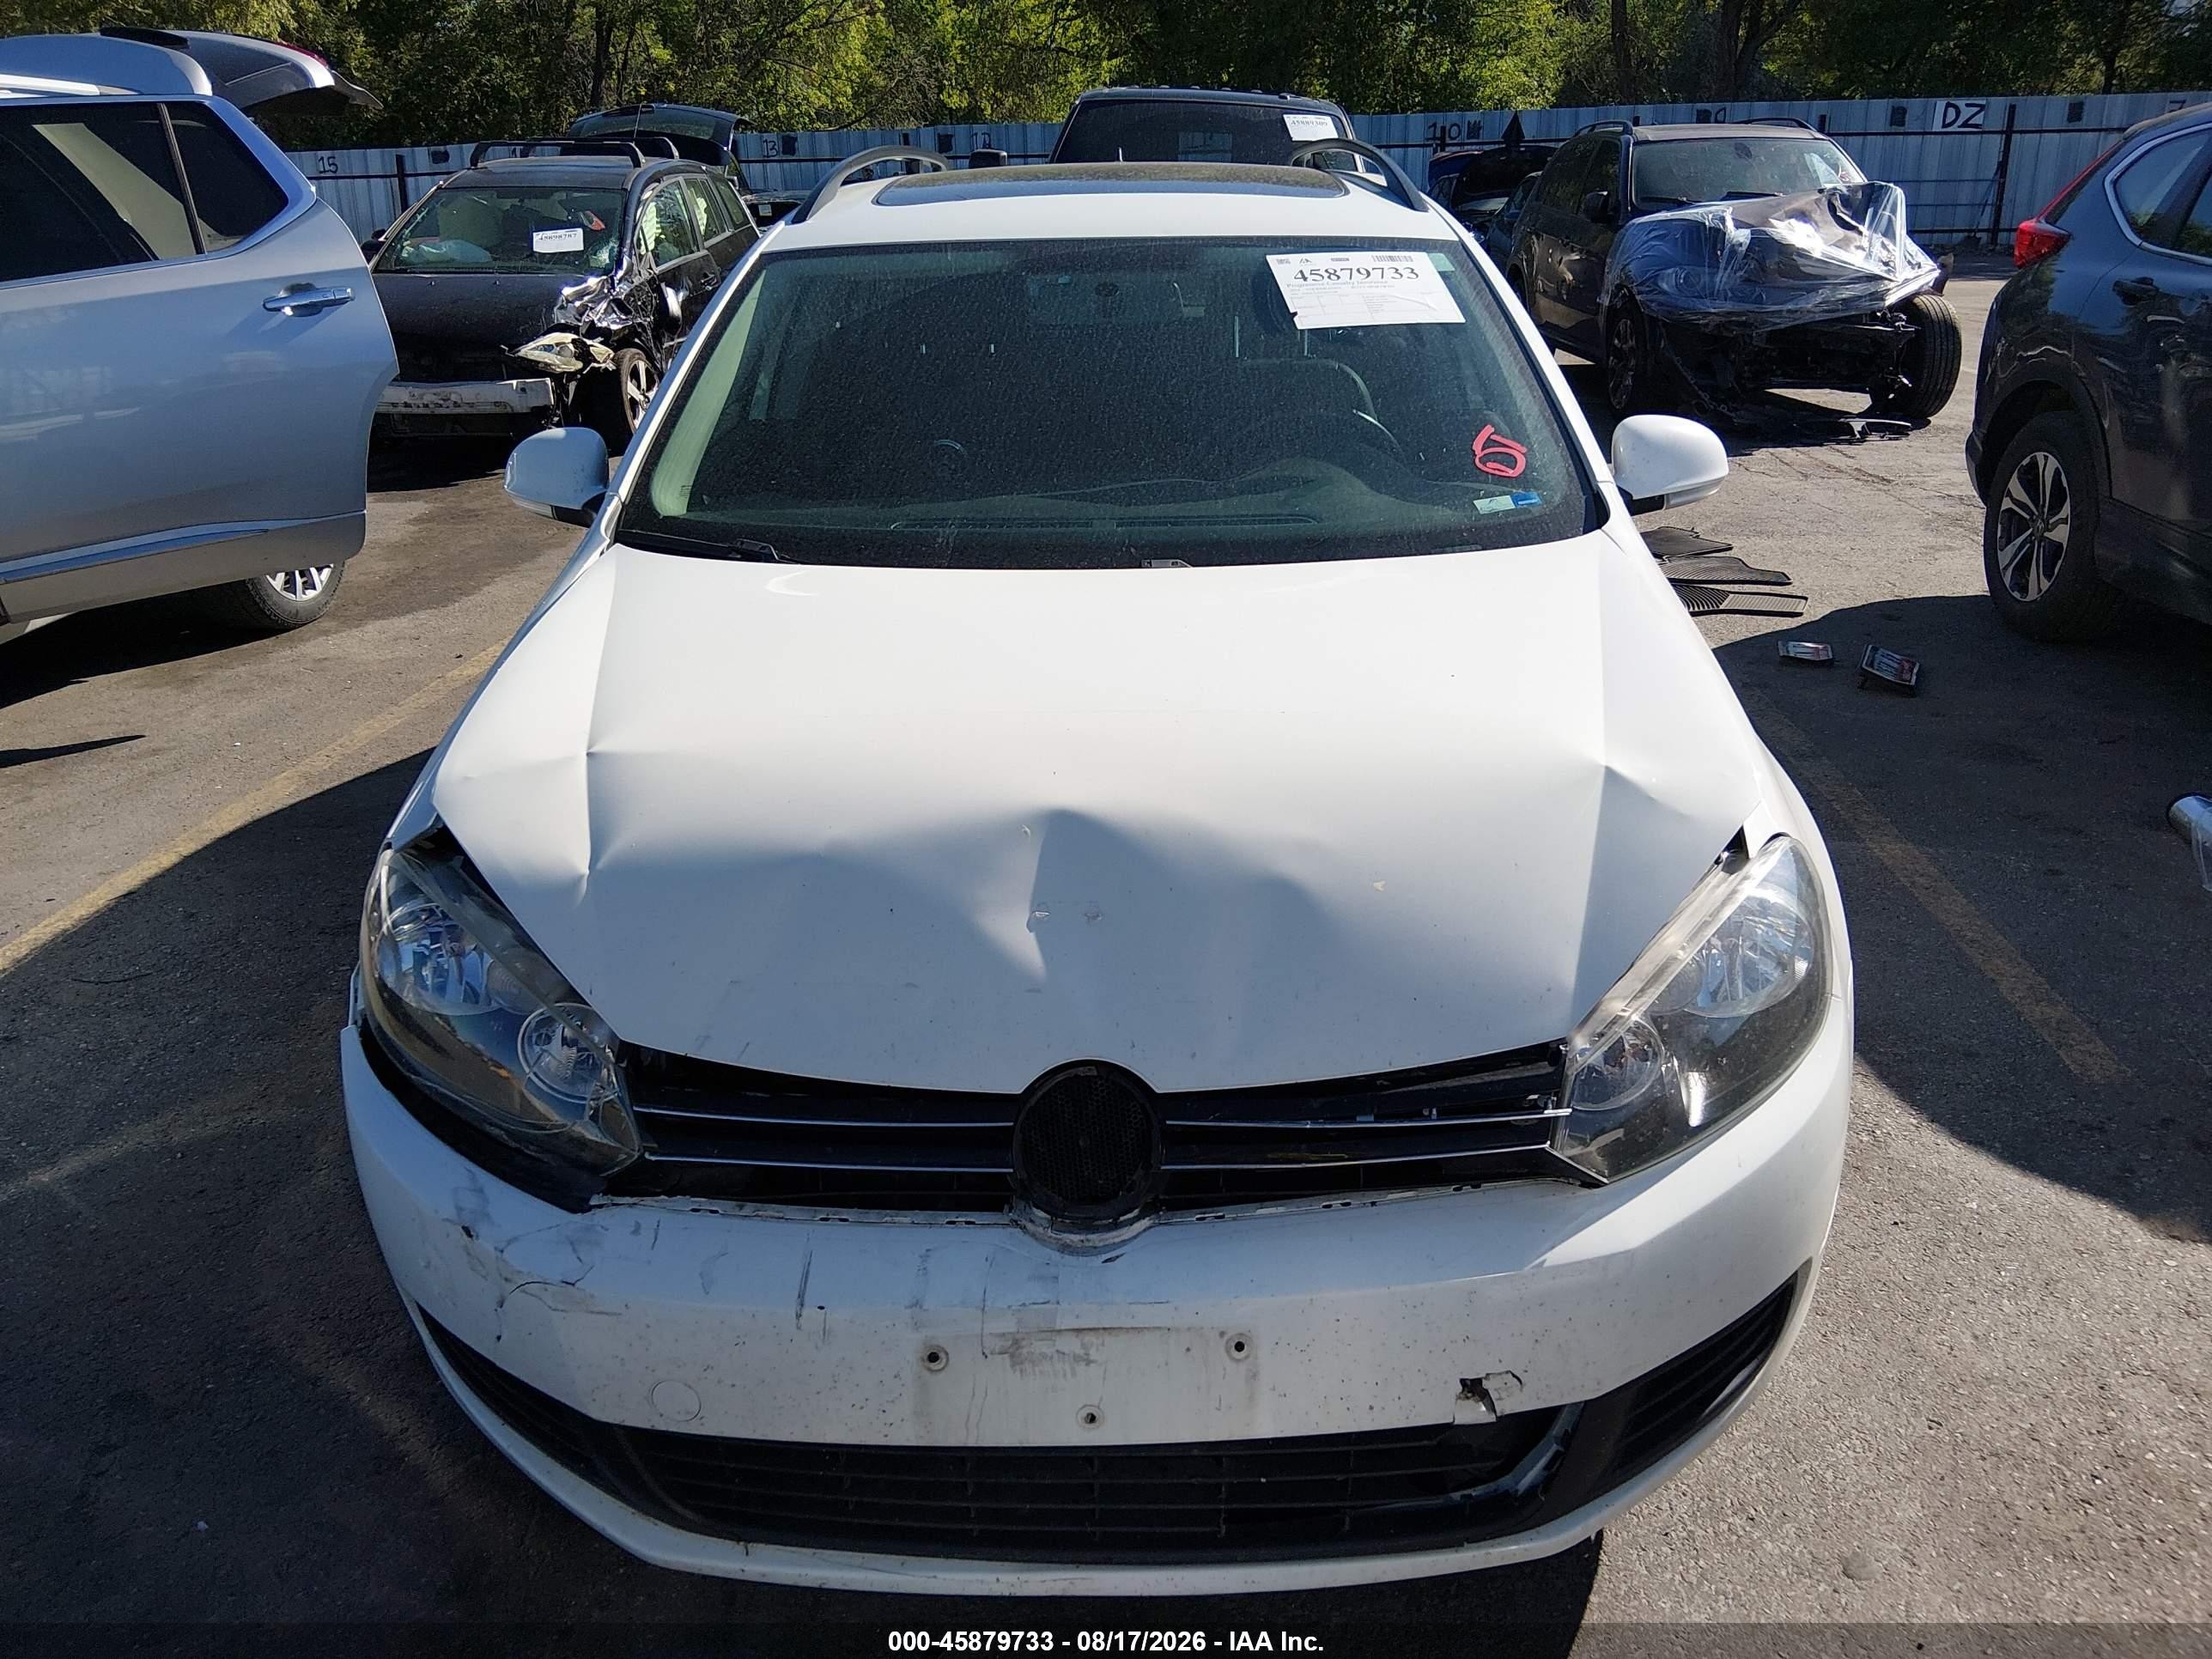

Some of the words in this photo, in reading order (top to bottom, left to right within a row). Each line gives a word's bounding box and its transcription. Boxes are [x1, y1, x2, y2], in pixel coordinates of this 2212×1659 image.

[763, 138, 778, 158] 13
[318, 156, 338, 173] 15
[1293, 267, 1419, 283] 45879733
